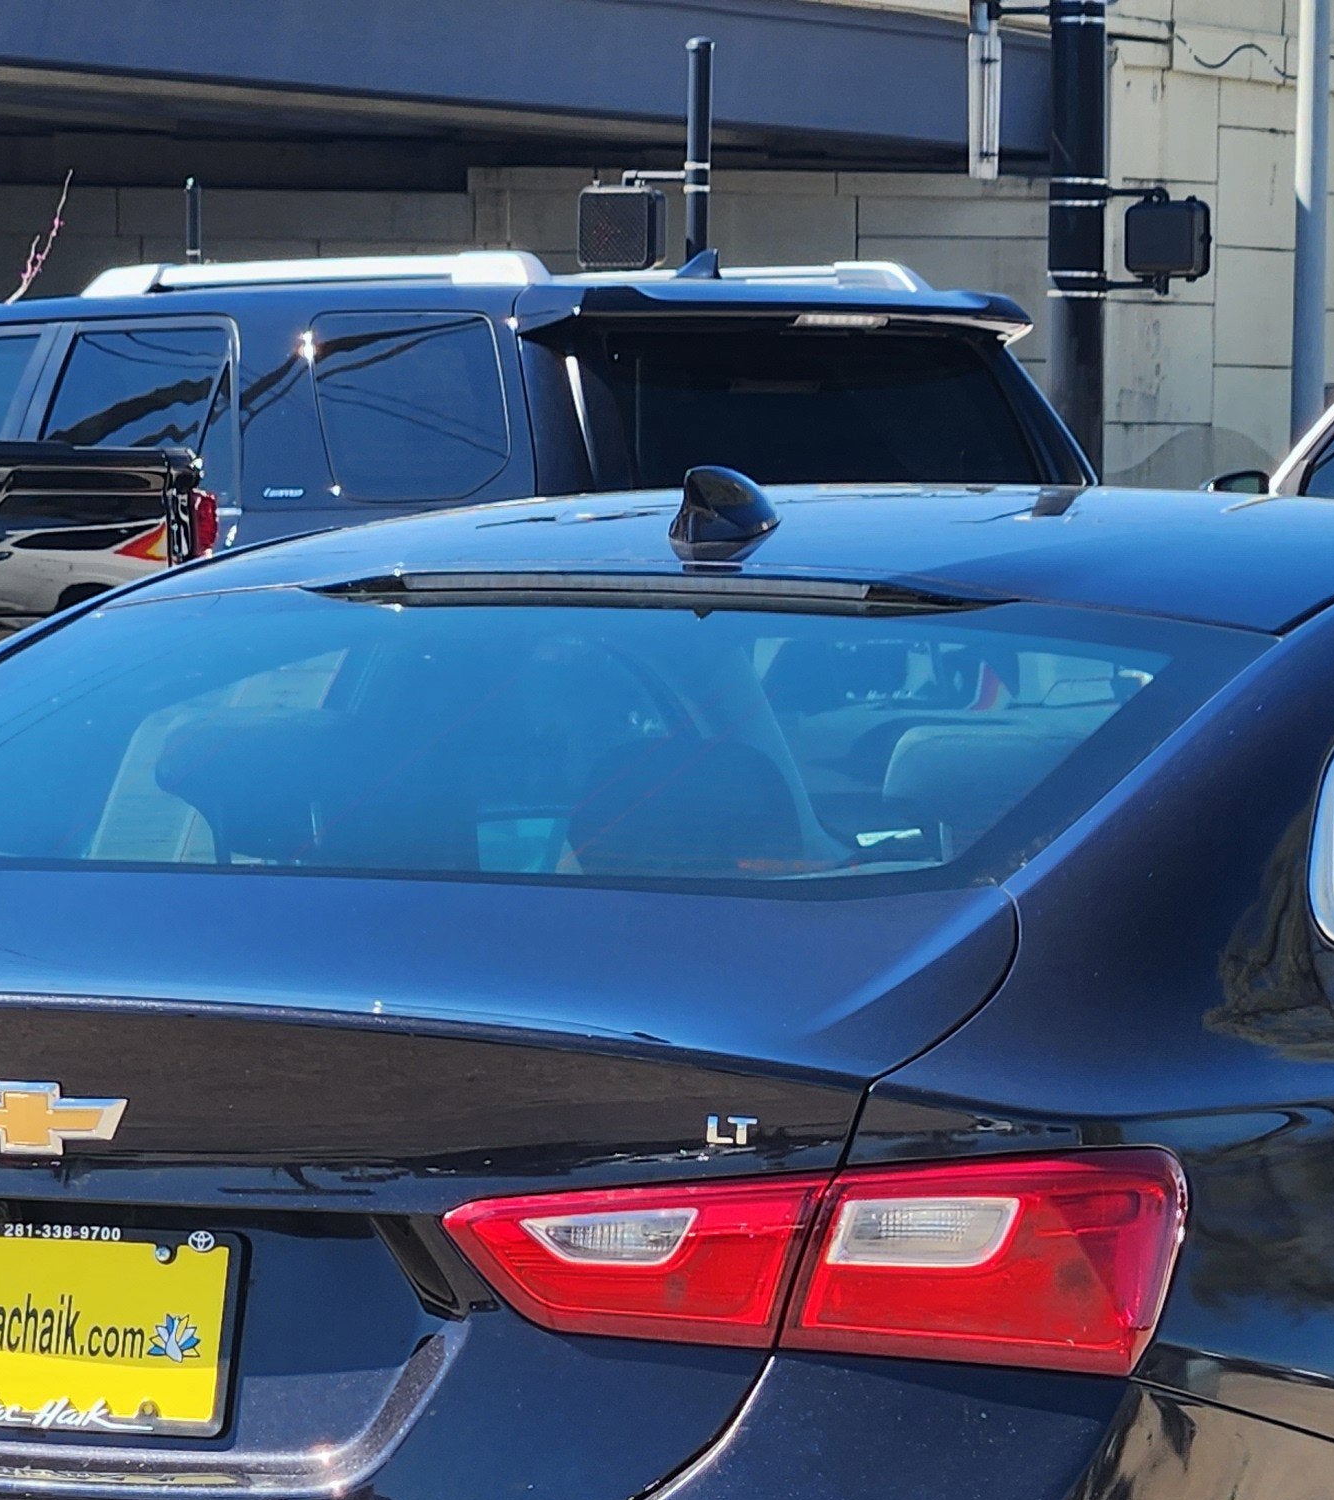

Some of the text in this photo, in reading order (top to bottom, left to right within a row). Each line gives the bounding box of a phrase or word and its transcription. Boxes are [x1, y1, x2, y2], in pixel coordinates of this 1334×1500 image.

[707, 1115, 758, 1145] LT
[3, 1223, 122, 1241] 281-338-9700
[24, 1397, 153, 1432] Haik
